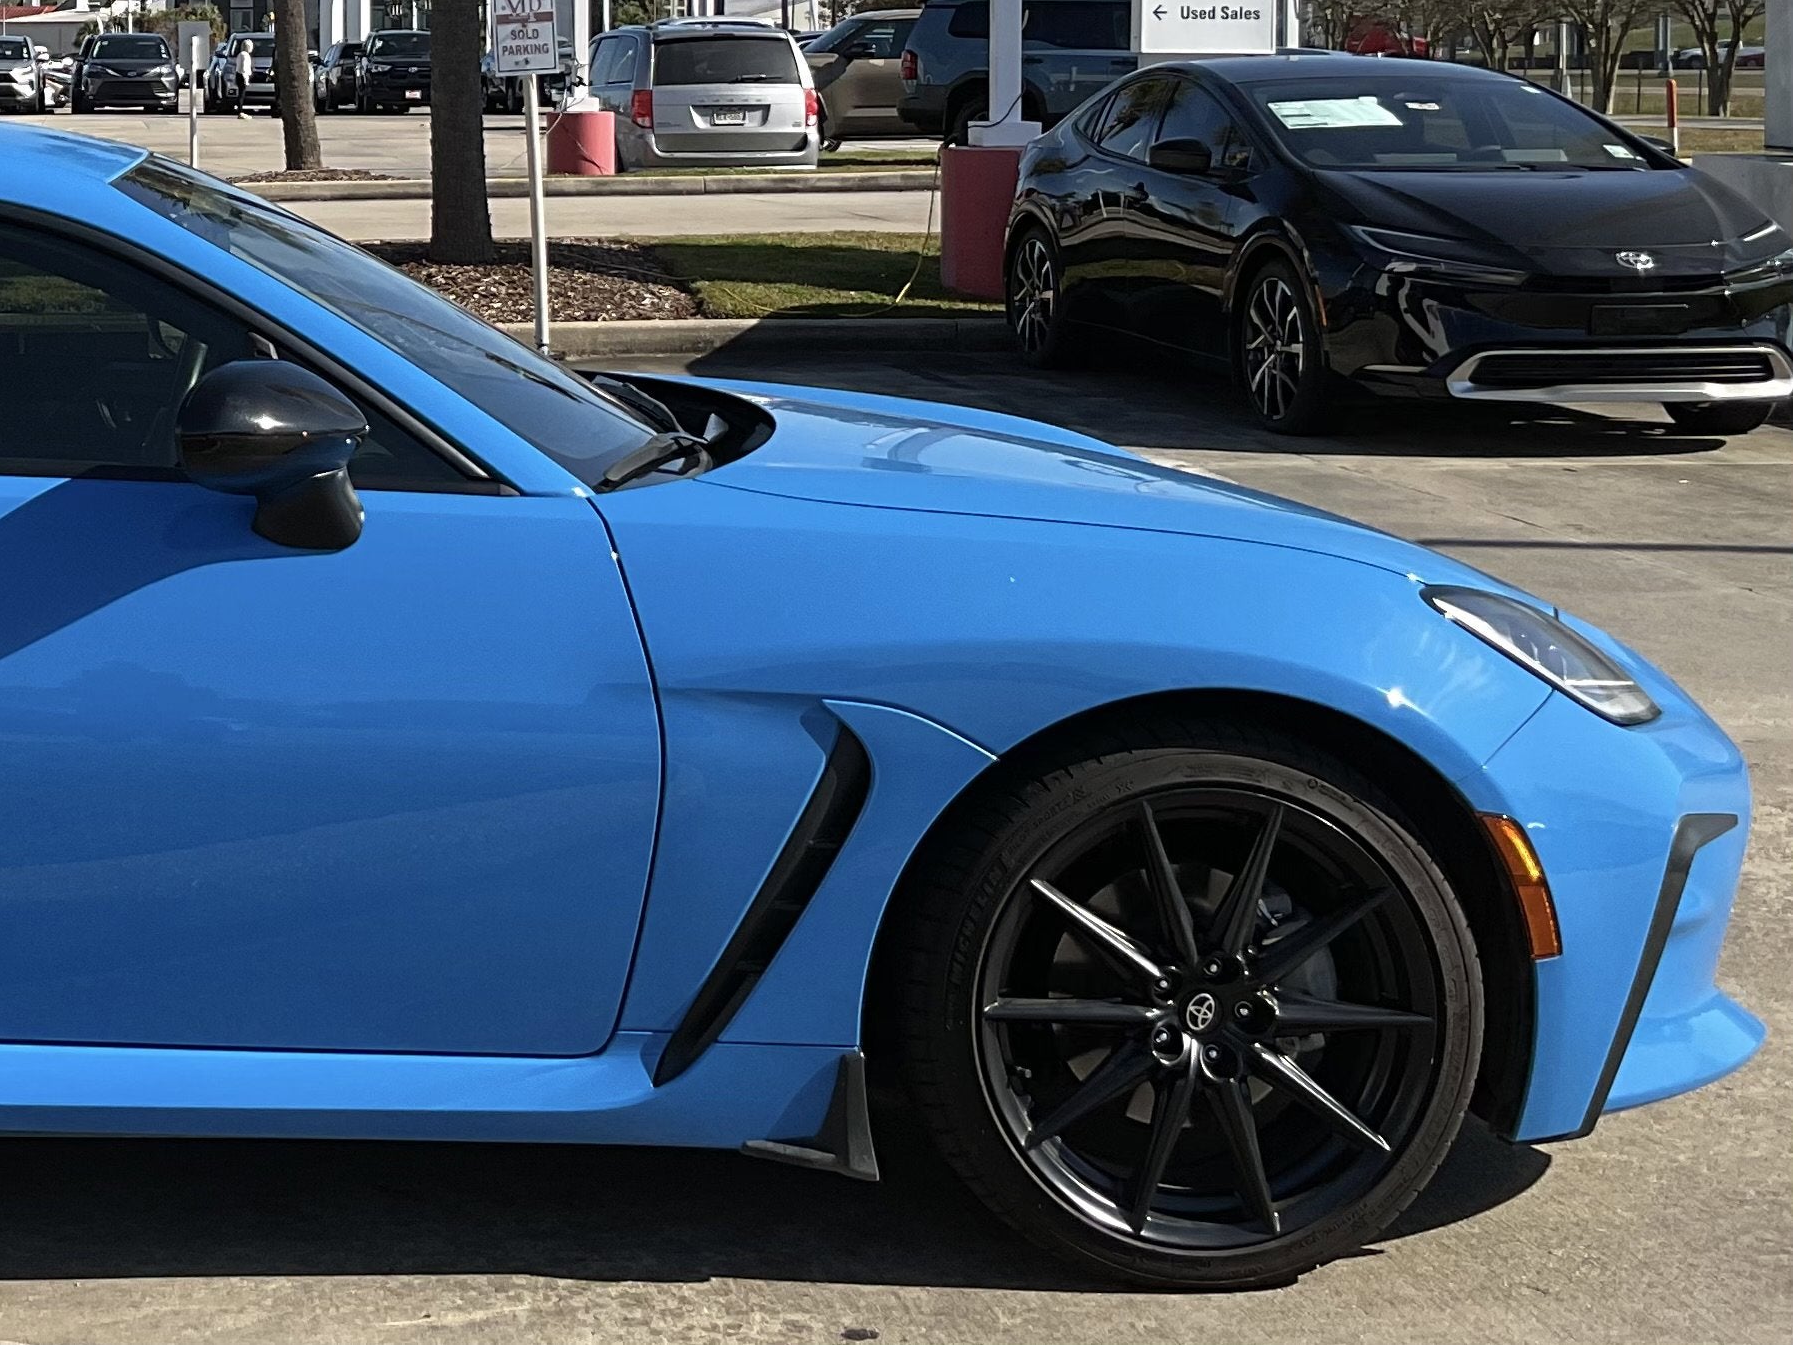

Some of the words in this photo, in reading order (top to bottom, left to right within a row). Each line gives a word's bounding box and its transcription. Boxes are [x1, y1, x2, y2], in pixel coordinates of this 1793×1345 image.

[1180, 6, 1216, 20] Used
[1220, 6, 1260, 20] Sales
[511, 29, 539, 40] SOLD
[502, 43, 549, 55] PARKING
